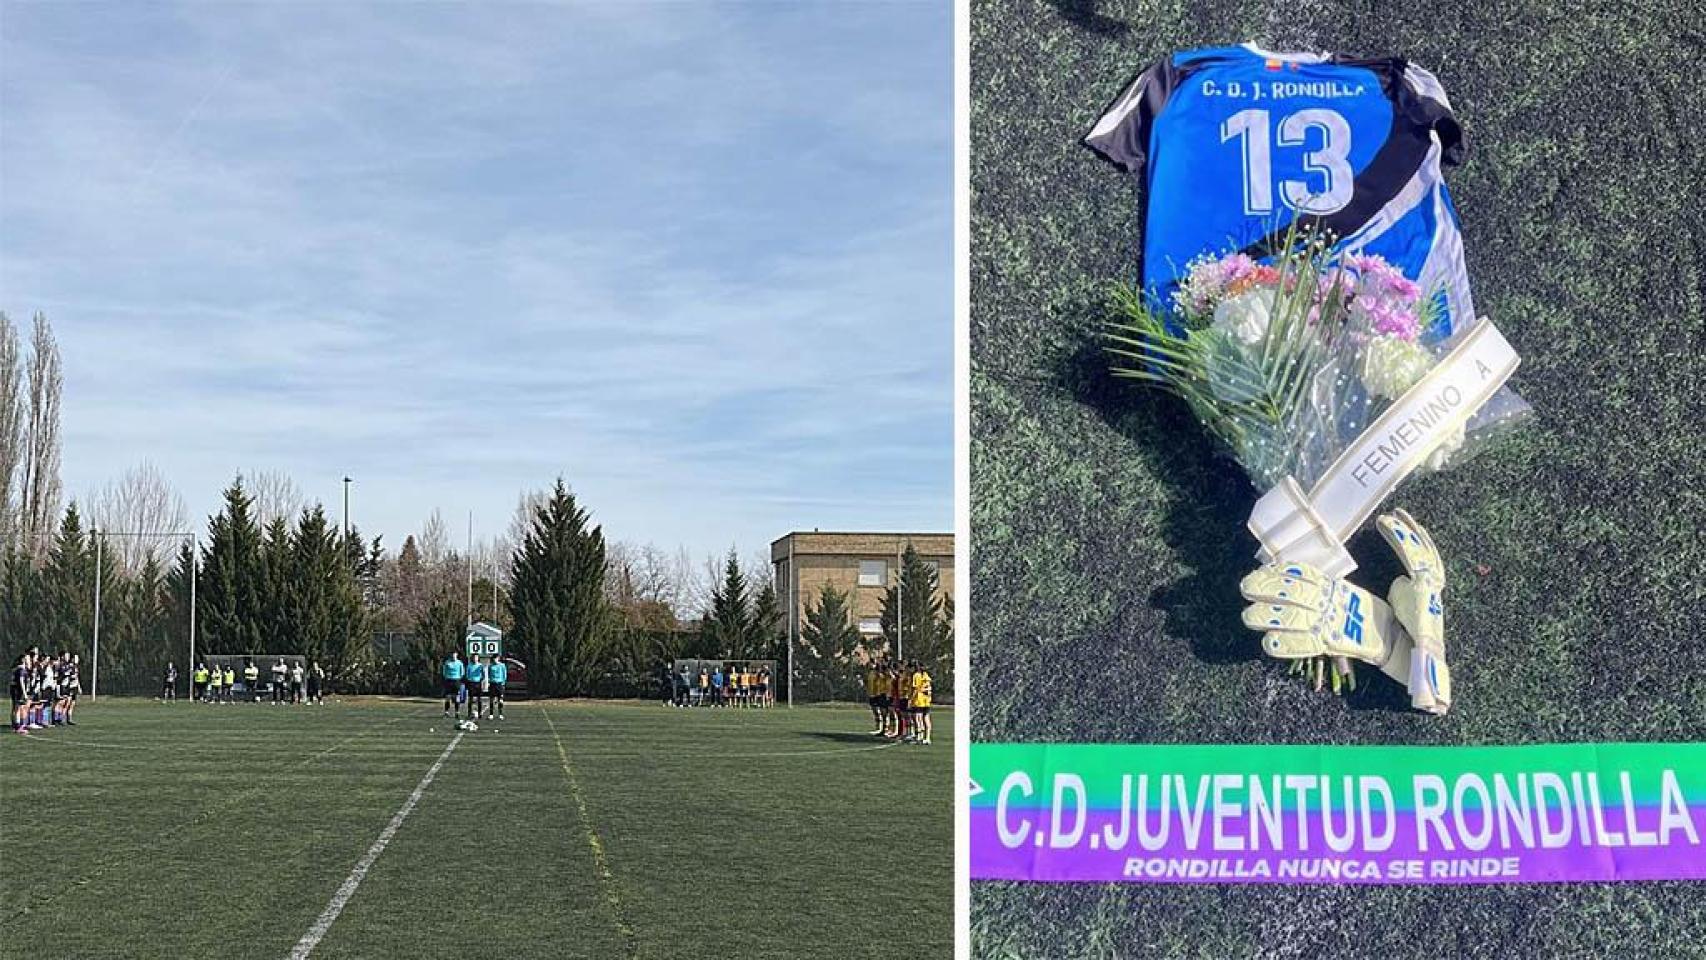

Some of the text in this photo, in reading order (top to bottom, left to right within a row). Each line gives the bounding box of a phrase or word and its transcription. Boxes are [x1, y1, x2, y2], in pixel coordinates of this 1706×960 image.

[1202, 80, 1222, 97] C.
[1227, 82, 1247, 98] D.
[1252, 82, 1267, 100] J.
[1220, 108, 1354, 215] 13
[1351, 359, 1492, 489] FEMENINO A
[1412, 769, 1700, 852] RONDILLA
[1123, 856, 1521, 880] RONDILLA NUNCA SE RINDE
